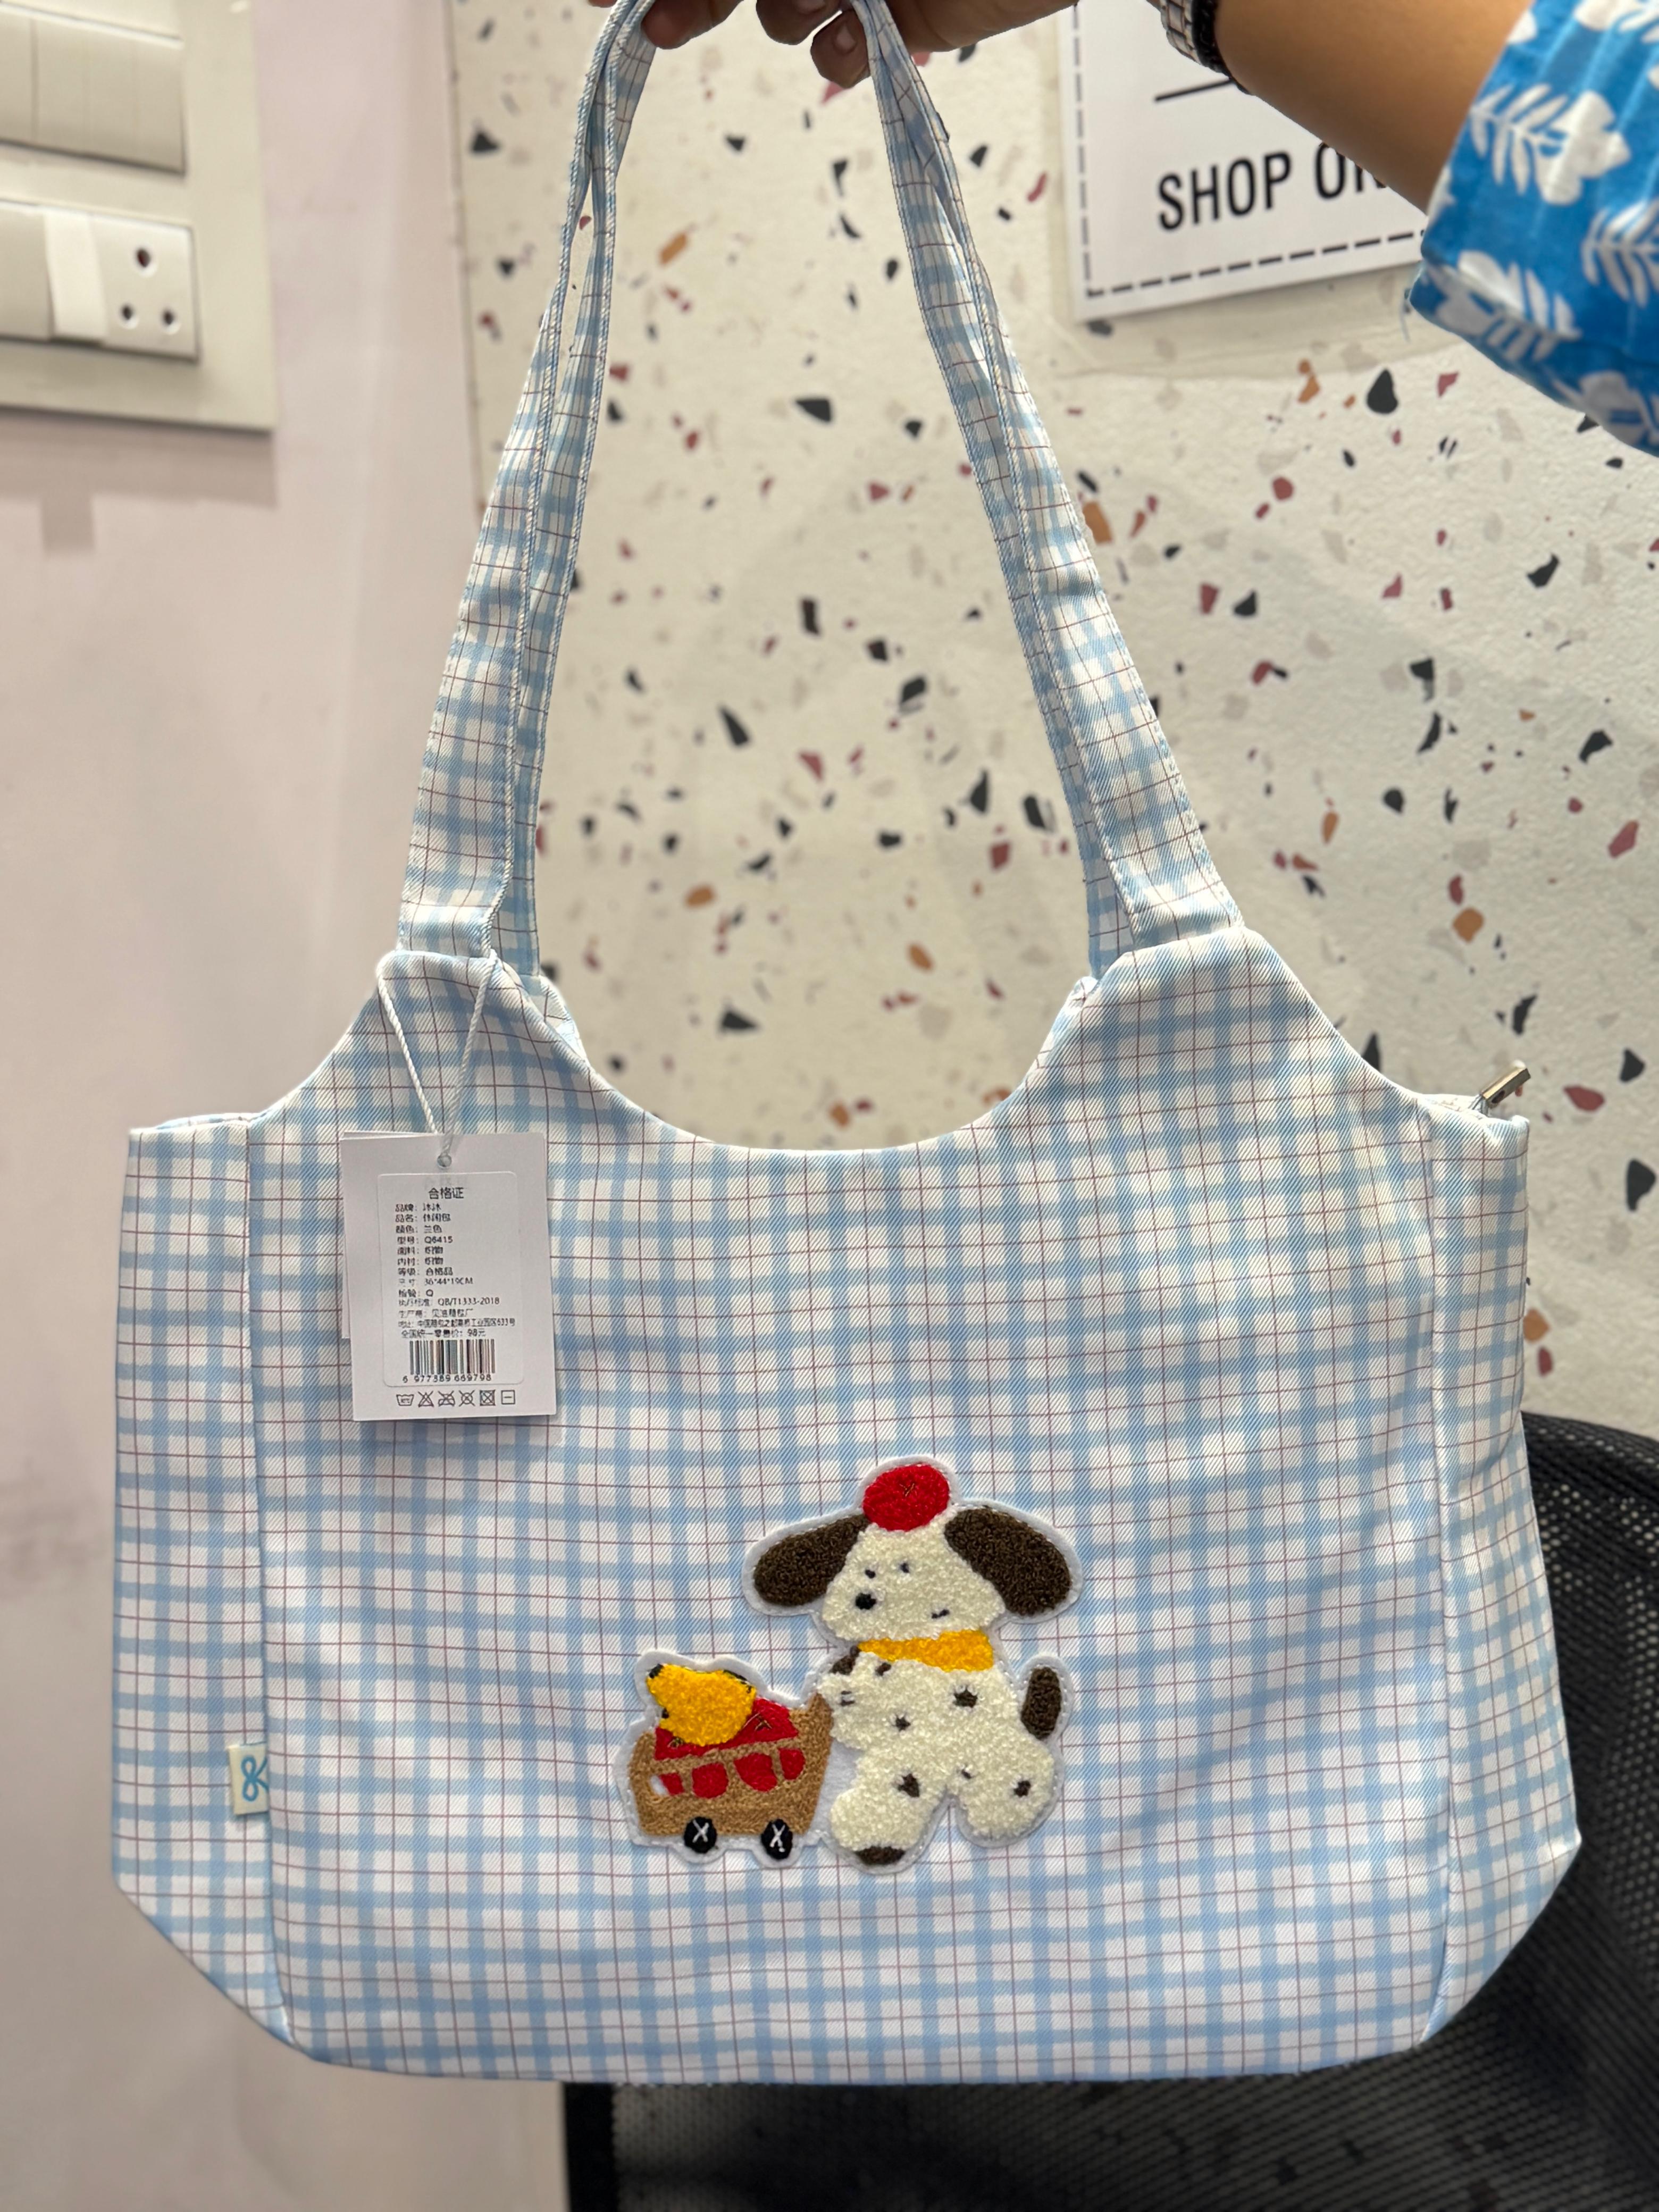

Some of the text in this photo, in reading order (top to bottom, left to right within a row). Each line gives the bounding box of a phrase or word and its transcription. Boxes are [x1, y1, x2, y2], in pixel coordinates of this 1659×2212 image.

[1158, 151, 1292, 231] SHOP
[429, 1187, 464, 1199] 合格证
